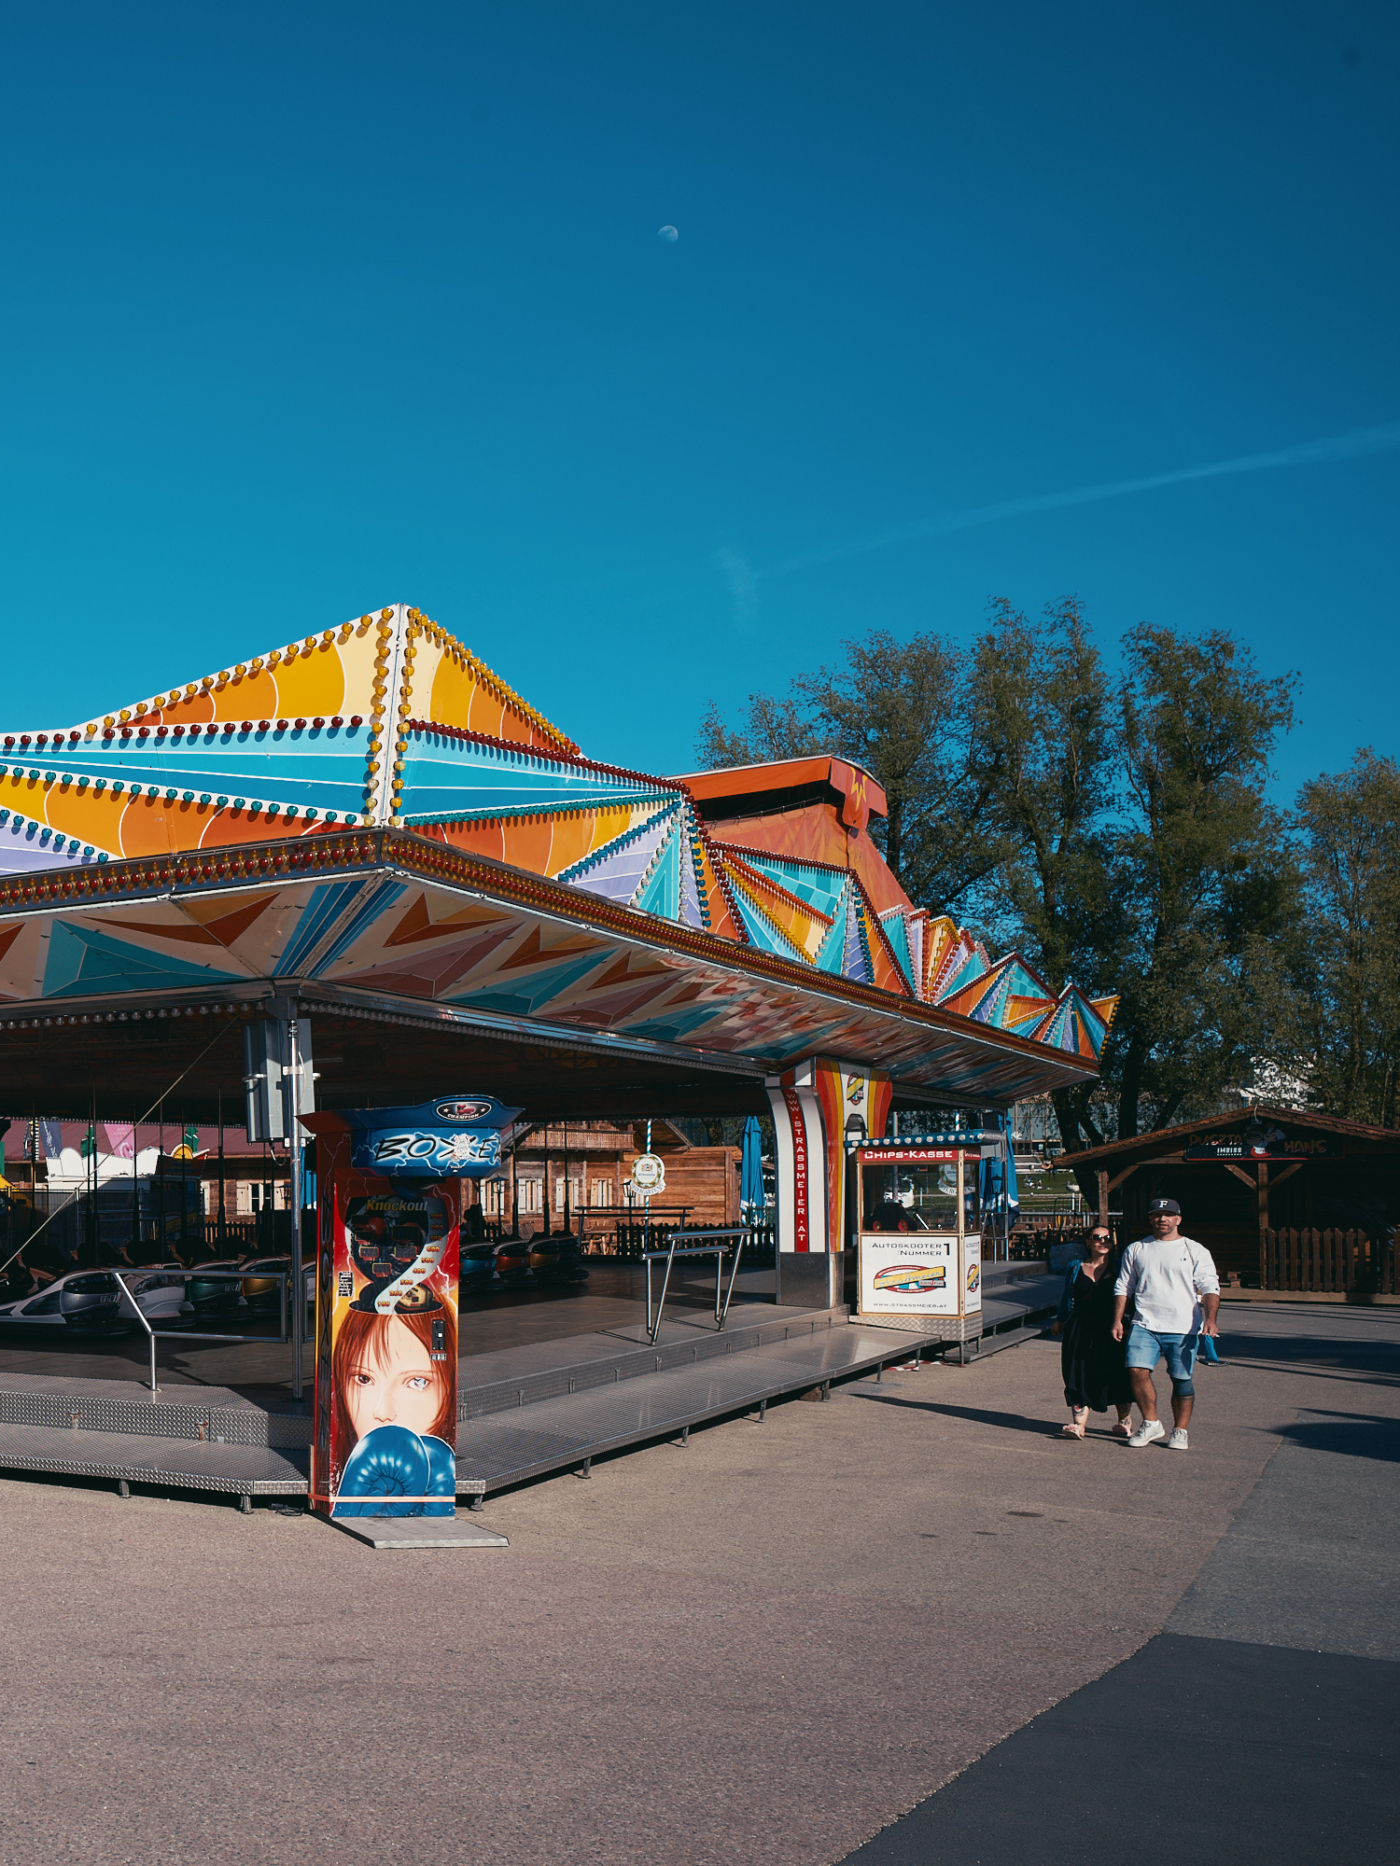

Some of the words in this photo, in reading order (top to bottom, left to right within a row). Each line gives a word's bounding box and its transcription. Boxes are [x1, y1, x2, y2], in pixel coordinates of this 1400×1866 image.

[1283, 1139, 1327, 1154] HANS
[366, 1199, 428, 1211] Knockout
[1158, 1200, 1168, 1208] F
[943, 1243, 951, 1256] 1
